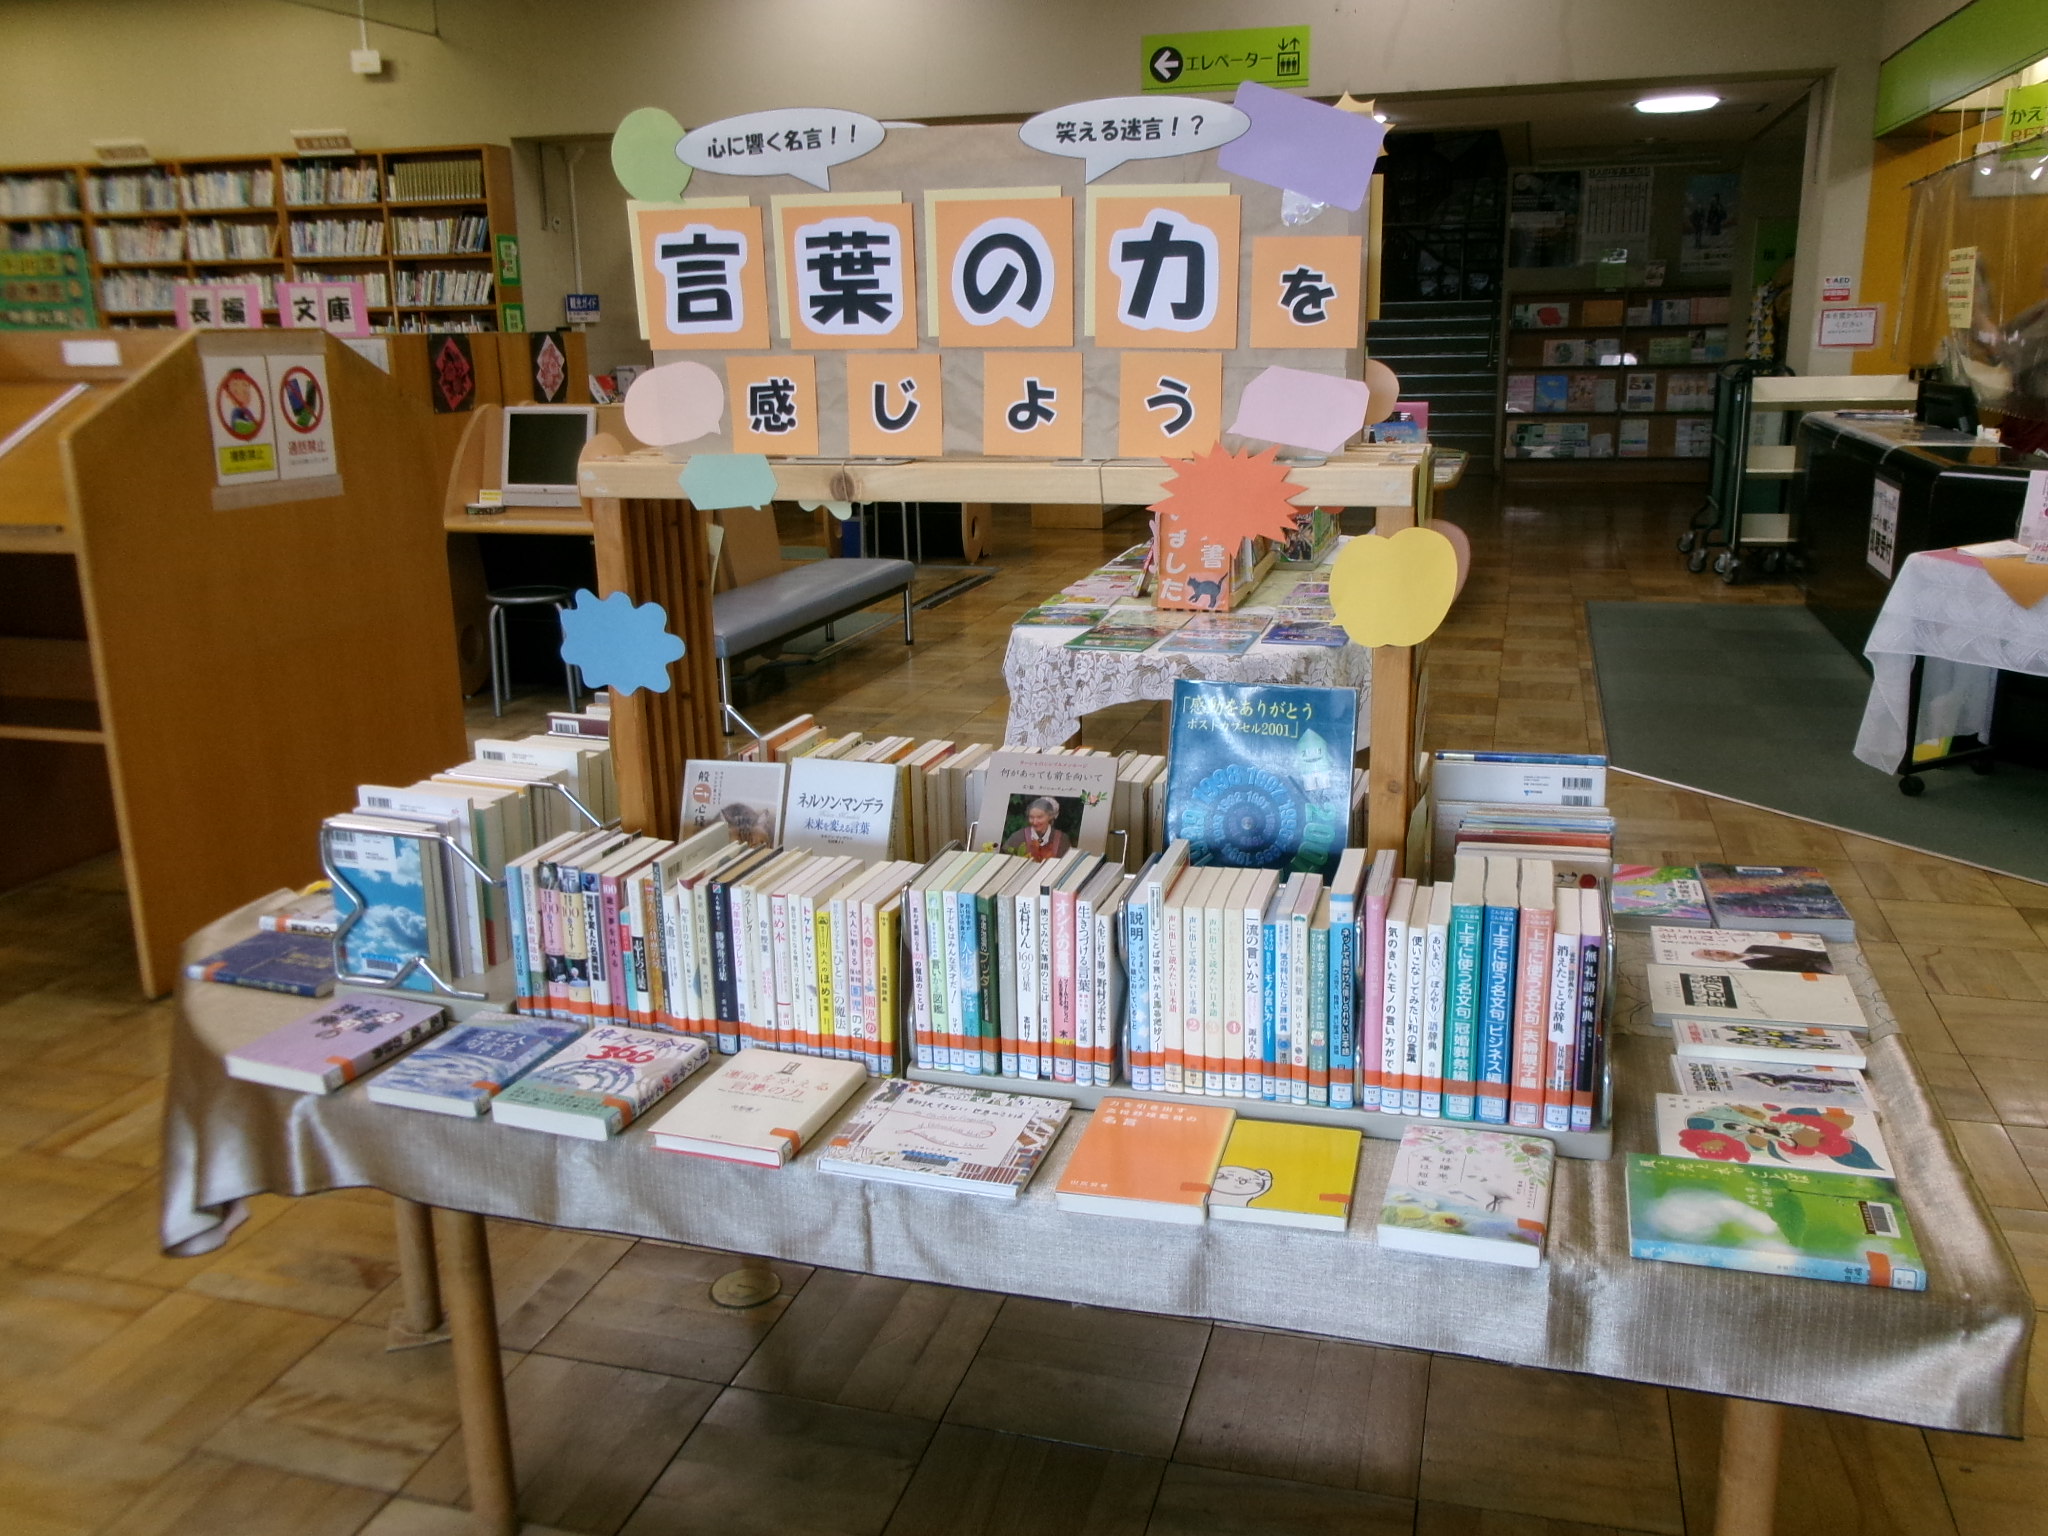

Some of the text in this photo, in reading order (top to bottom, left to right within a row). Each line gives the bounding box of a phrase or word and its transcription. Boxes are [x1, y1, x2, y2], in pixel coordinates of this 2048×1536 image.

[1186, 52, 1273, 71] エレベーター
[707, 124, 856, 158] 心に響く名言！！
[1056, 115, 1204, 144] 笑える迷言！？
[2009, 106, 2048, 126] かえ
[292, 296, 351, 323] 文庫
[798, 792, 884, 814] ネルソン・マンデラ
[1001, 767, 1103, 782] 何があっても前を向いて
[804, 817, 871, 835] 未来を変える言葉
[1019, 902, 1031, 949] 志村けん
[1077, 905, 1091, 992] 生きつづける言葉
[1245, 917, 1260, 994] 一流の言いかえ
[1168, 915, 1177, 1013] 声に出して読みたい日本語
[1188, 916, 1197, 1015] 声に出して読みたい日本語
[1209, 918, 1218, 1017] 声に出して読みたい日本語
[1340, 928, 1350, 1056] ネットで見かけた信じられない日本語
[1406, 935, 1423, 1064] 使いこなしてみたい和の言葉
[1456, 922, 1474, 1020] 上手に使う名文句
[1490, 925, 1509, 1021] 上手に使う名文句
[1522, 931, 1545, 1026] 上手に使う名文句
[1553, 944, 1569, 1035] 消えたことば辞典
[1582, 950, 1598, 1023] 無礼語辞典
[585, 1045, 656, 1064] 366
